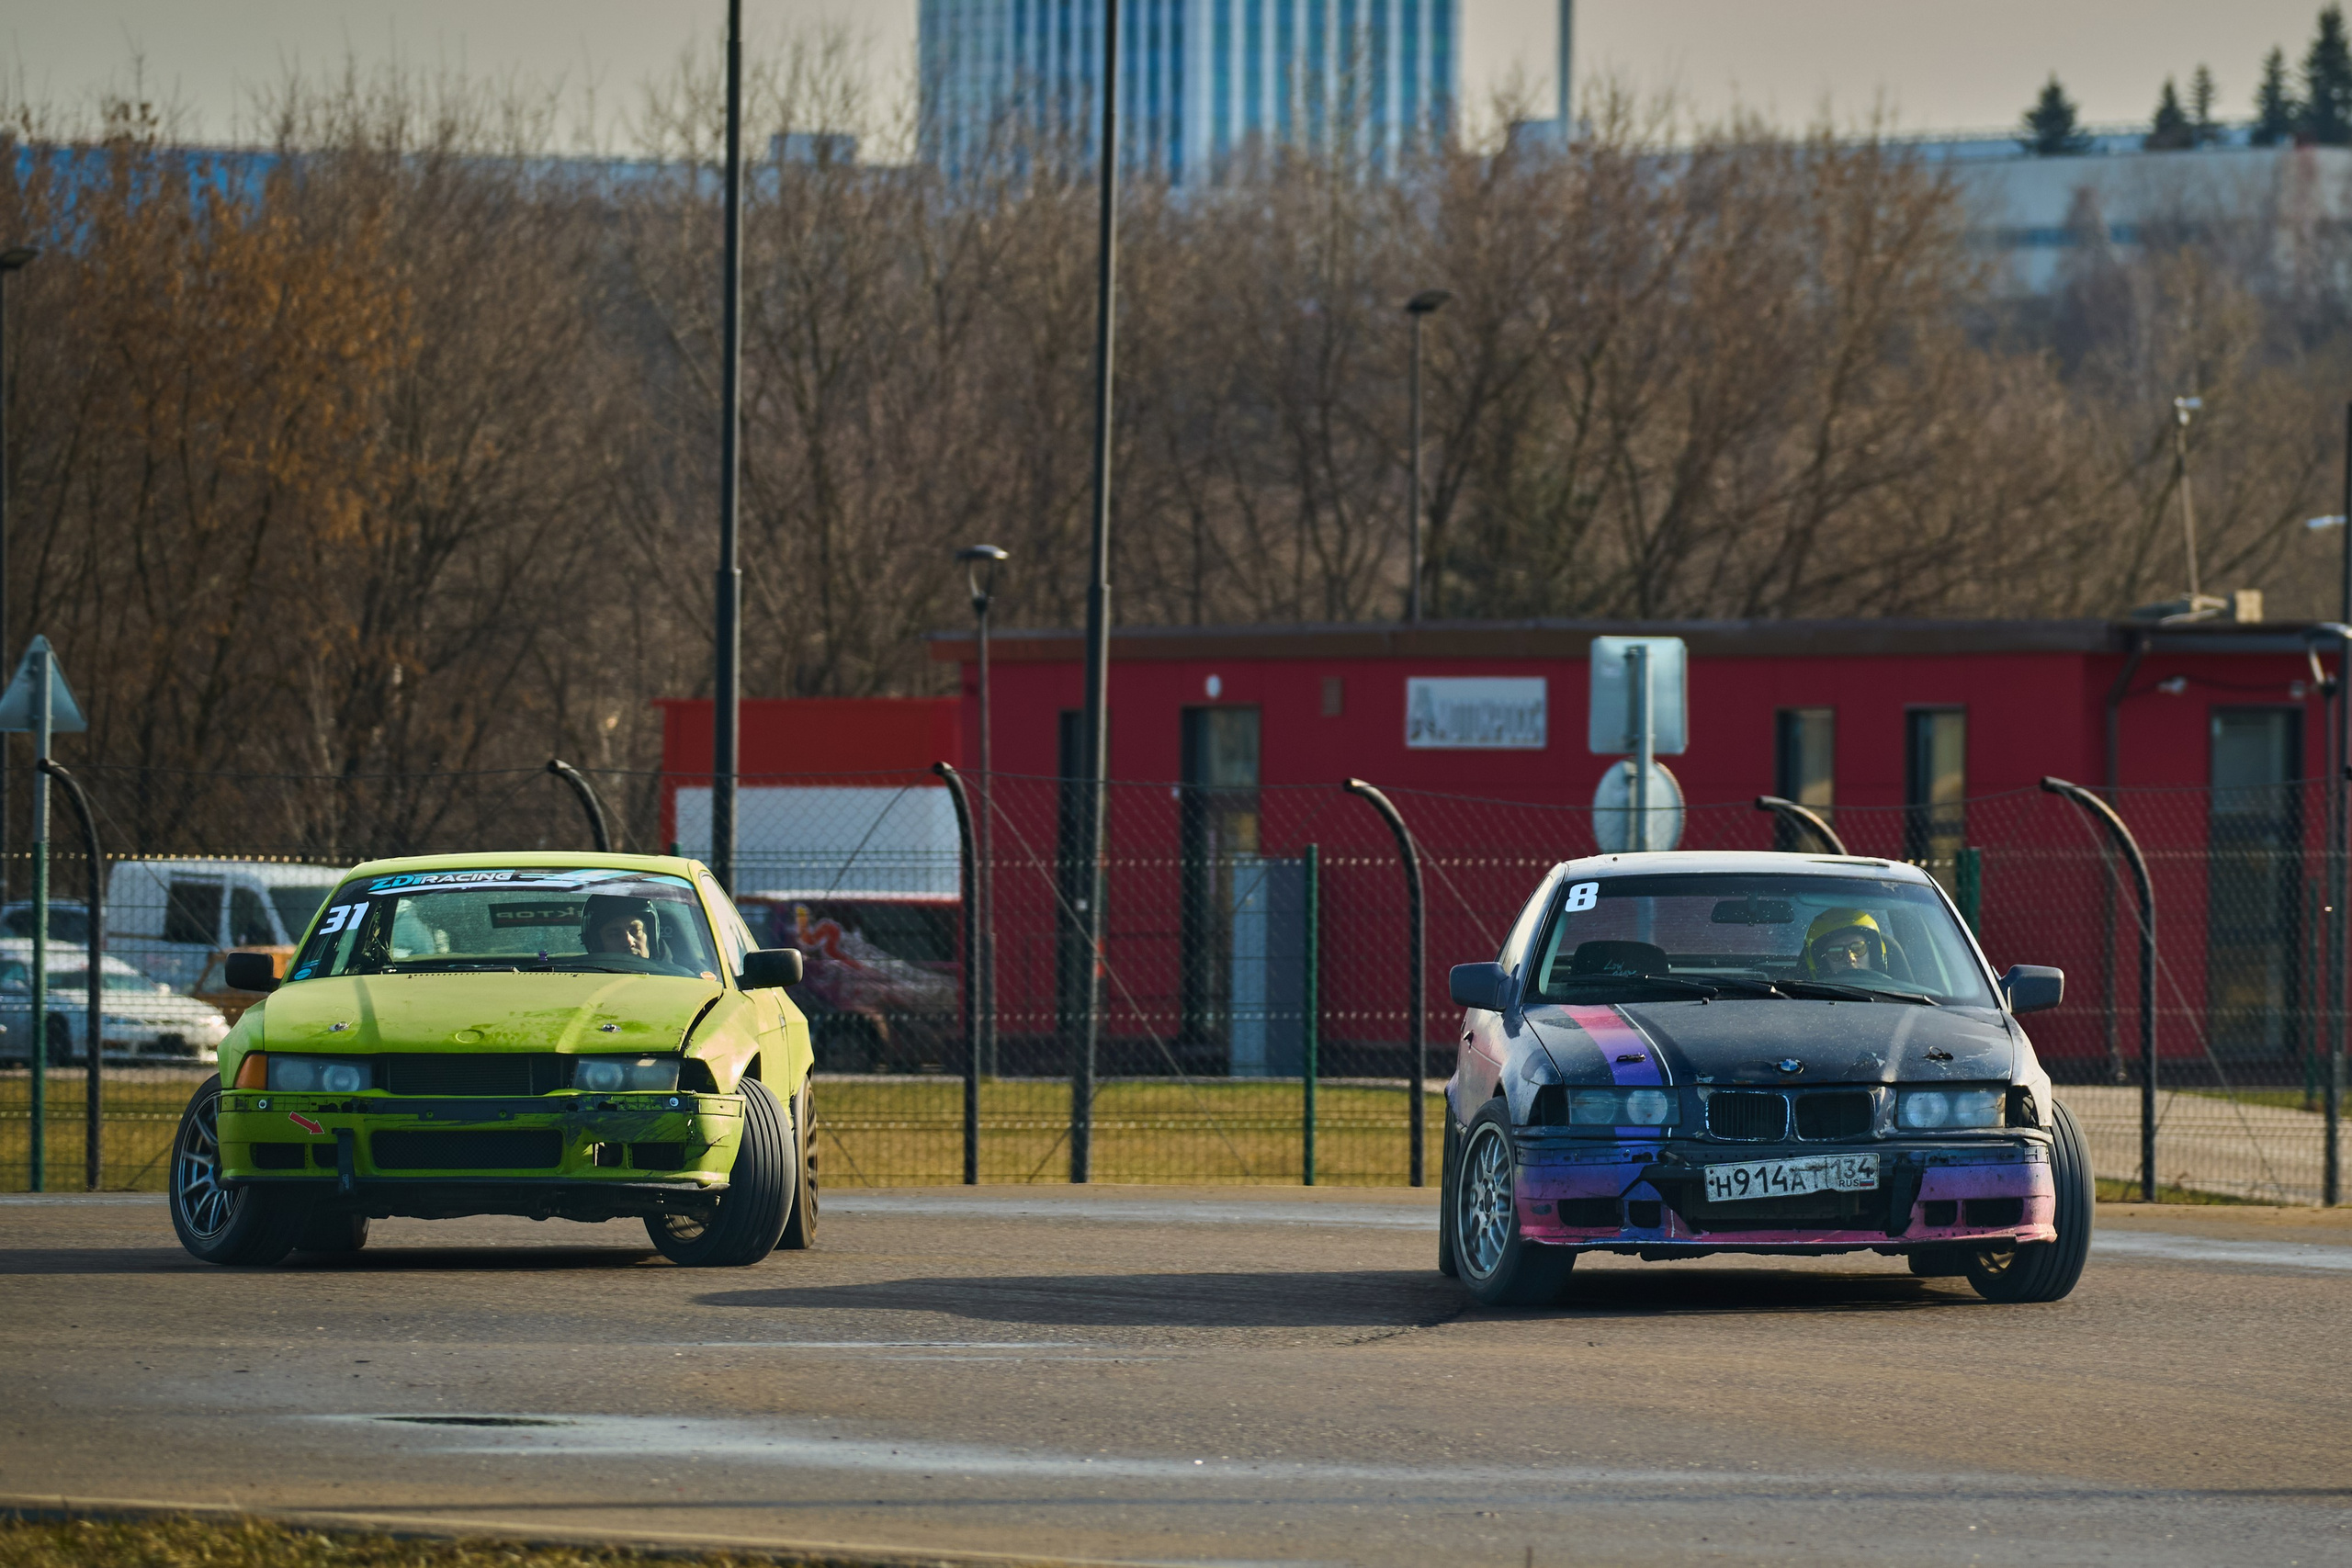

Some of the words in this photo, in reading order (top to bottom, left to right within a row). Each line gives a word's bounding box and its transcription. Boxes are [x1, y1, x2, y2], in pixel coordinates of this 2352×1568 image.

[1565, 882, 1599, 911] 8
[319, 901, 369, 935] 31
[1838, 1179, 1860, 1188] RUS
